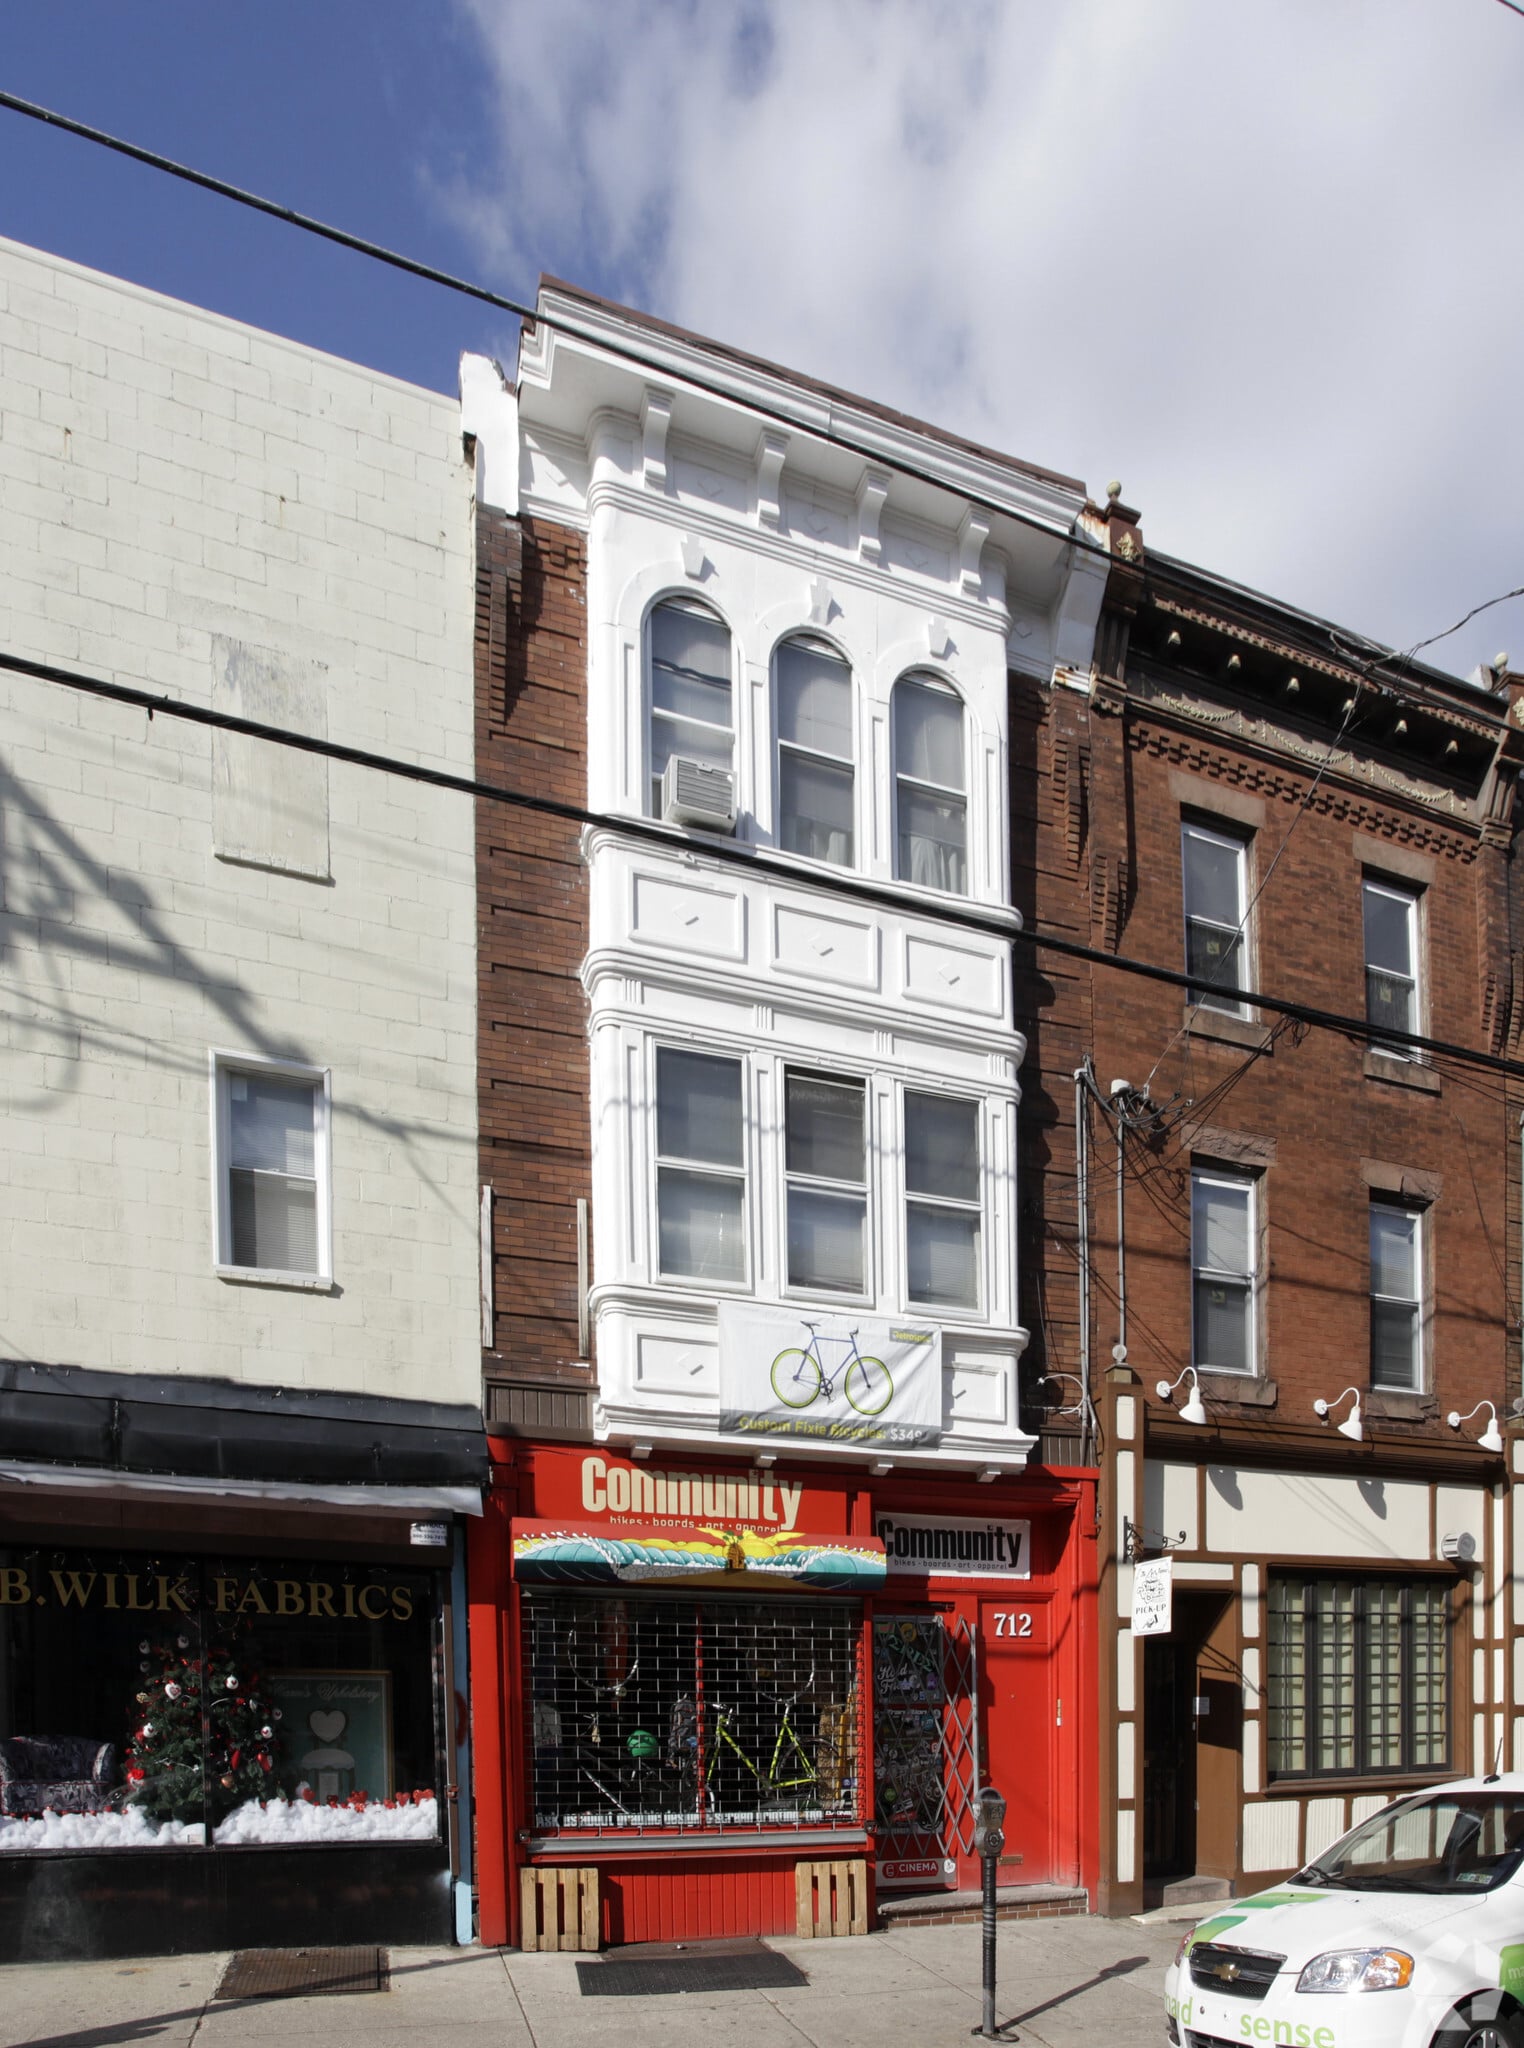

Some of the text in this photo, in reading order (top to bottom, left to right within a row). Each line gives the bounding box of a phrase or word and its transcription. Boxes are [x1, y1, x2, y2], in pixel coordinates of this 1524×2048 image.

[739, 1416, 791, 1431] Custom
[795, 1421, 826, 1435] Fixie
[582, 1457, 803, 1531] Community
[653, 1517, 695, 1529] boards
[878, 1519, 1022, 1568] Community
[894, 1558, 1007, 1571] bikes boards art apparel
[213, 1577, 413, 1621] FABRICS
[993, 1613, 1032, 1637] 712
[899, 1859, 937, 1872] CINEMA
[1240, 2013, 1336, 2048] sense
